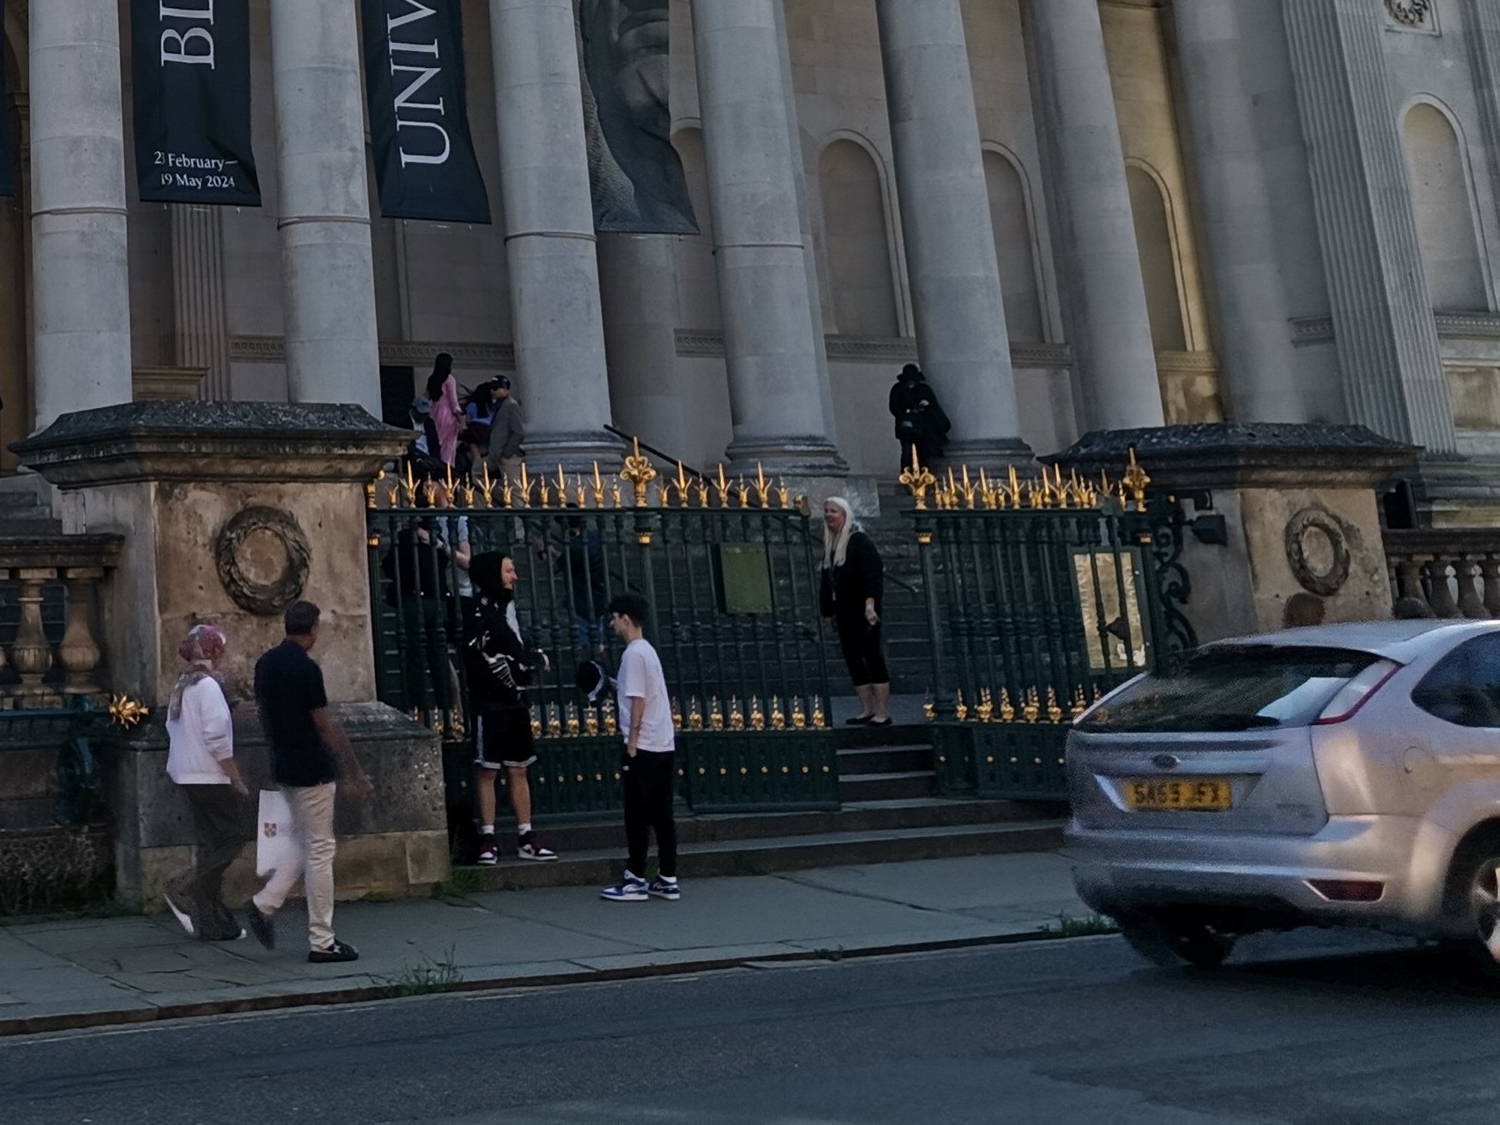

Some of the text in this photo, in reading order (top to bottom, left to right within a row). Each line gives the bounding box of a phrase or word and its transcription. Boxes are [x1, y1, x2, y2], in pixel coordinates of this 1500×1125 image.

[160, 173, 236, 190] 19 May 2024
